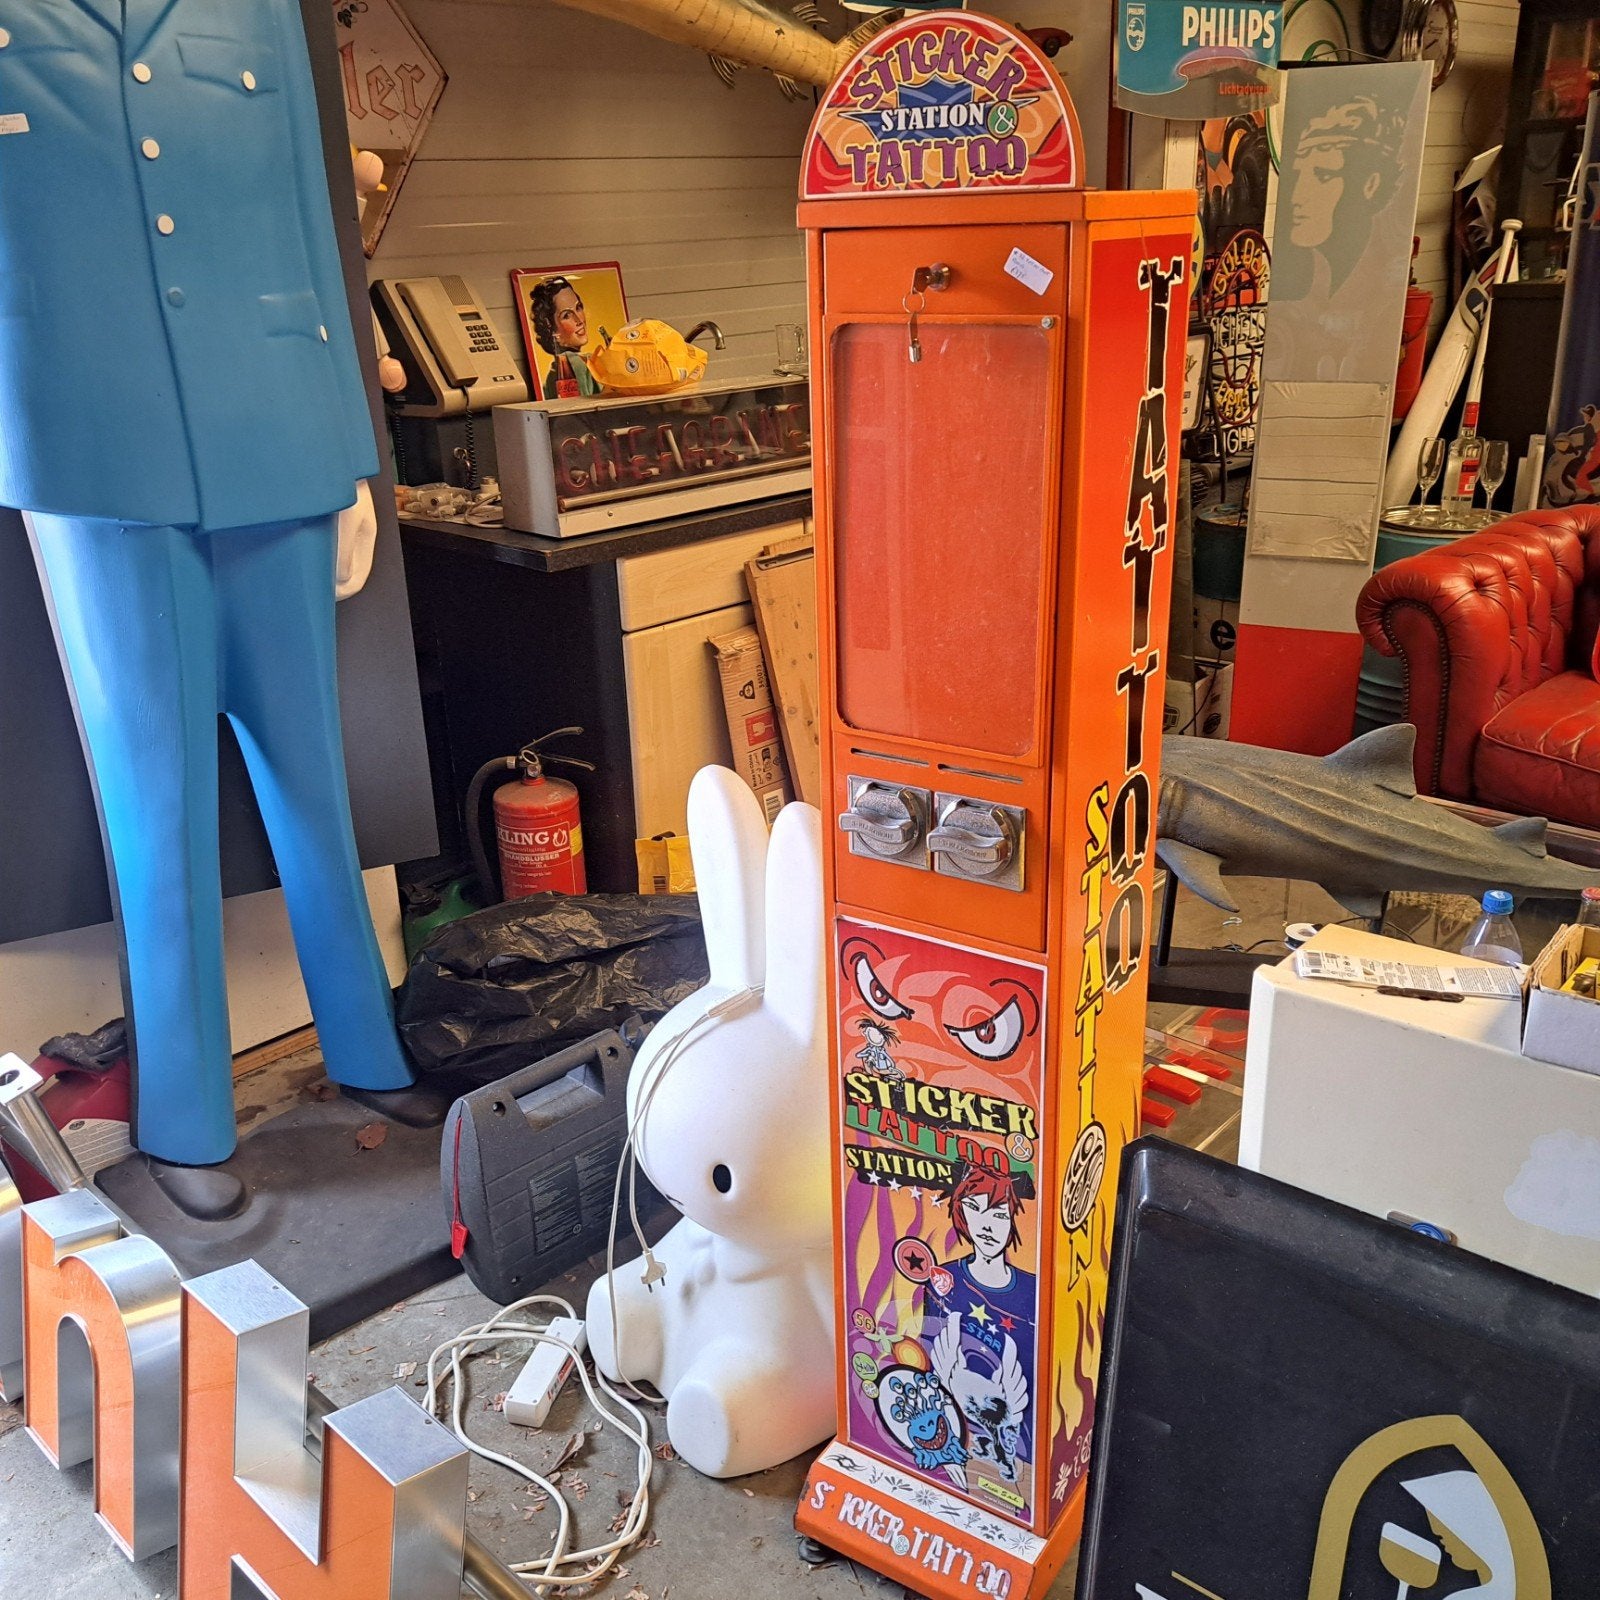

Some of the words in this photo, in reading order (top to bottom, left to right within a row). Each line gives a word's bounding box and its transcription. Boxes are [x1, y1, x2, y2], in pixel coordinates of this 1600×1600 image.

[1182, 6, 1275, 49] PHILIPS
[849, 28, 1025, 109] STICKER
[880, 102, 985, 132] STATION
[993, 105, 1016, 134] &
[846, 134, 1028, 186] TATTOO
[1105, 256, 1185, 996] TATTOO
[846, 1073, 1037, 1139] STICKER
[851, 1098, 1010, 1178] TATTOO
[1012, 1134, 1032, 1159] &
[846, 1147, 953, 1184] STATION
[967, 1322, 1002, 1351] STAR
